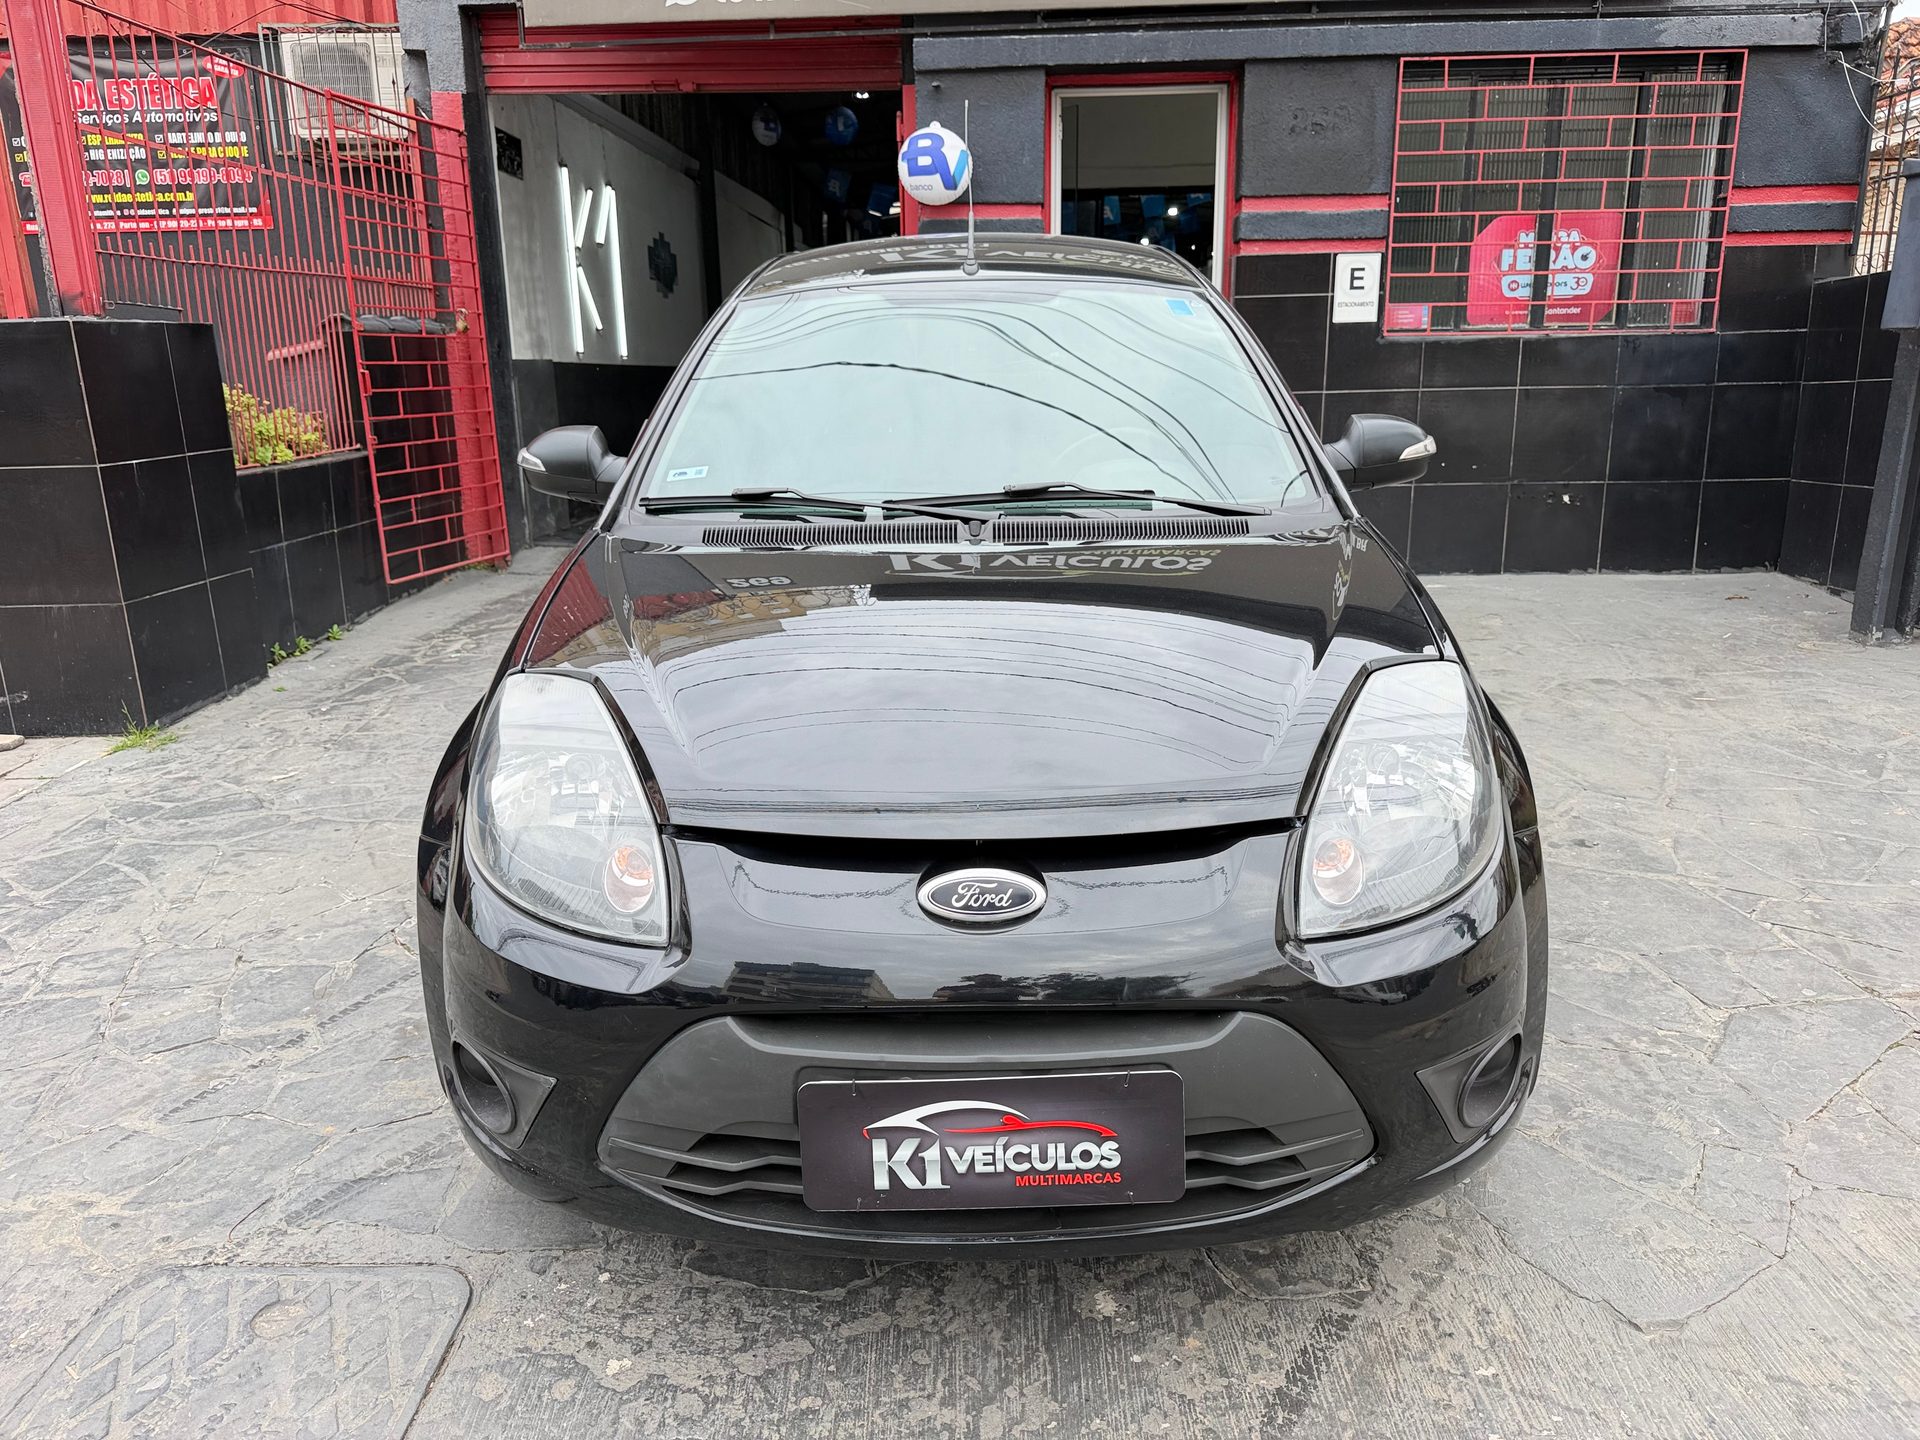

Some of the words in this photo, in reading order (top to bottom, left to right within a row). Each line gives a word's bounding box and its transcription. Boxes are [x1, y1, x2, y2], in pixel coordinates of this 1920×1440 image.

[901, 132, 969, 191] BV
[910, 183, 933, 192] banco
[558, 164, 629, 360] K1
[1349, 267, 1366, 290] E
[951, 881, 1014, 908] Ford
[872, 1137, 950, 1190] K1
[945, 1136, 1122, 1174] VEÍCULOS
[1015, 1172, 1122, 1187] MULTIMARCAS
